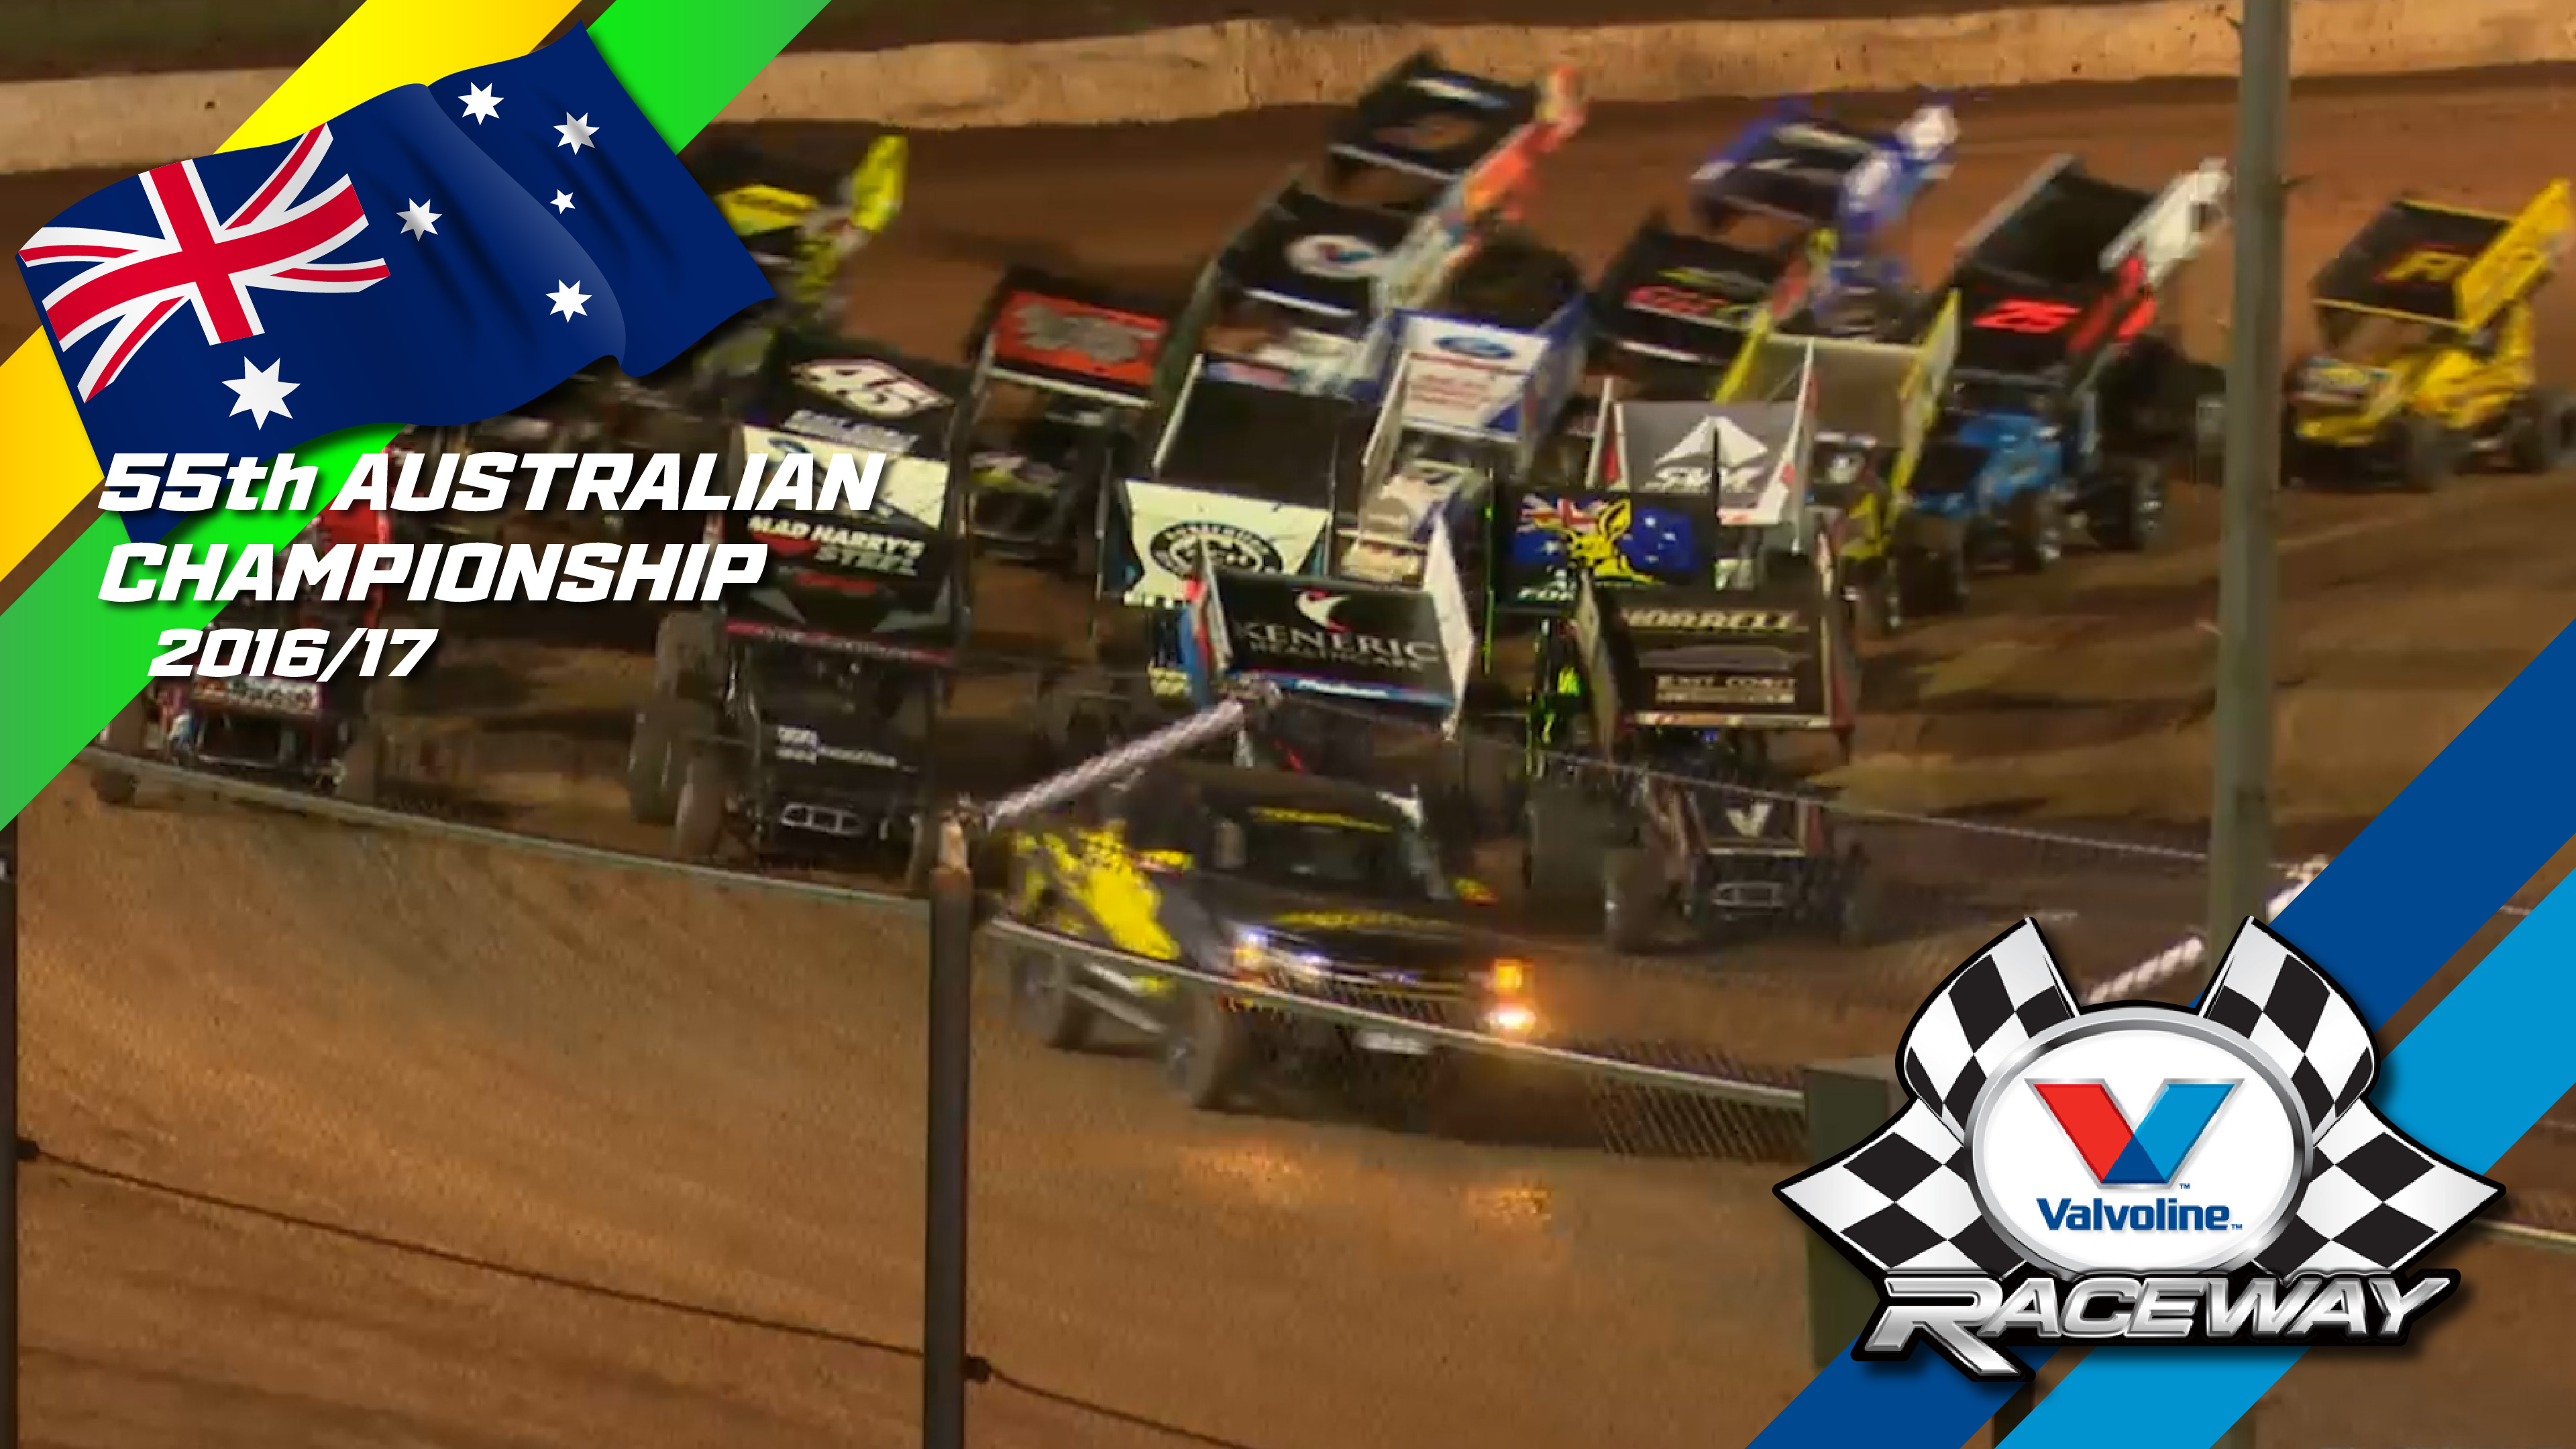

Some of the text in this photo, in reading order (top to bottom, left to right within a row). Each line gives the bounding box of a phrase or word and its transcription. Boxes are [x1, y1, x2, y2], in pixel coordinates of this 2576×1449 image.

[747, 515, 920, 557] MAD HARRY'S
[813, 545, 918, 576] STEEL
